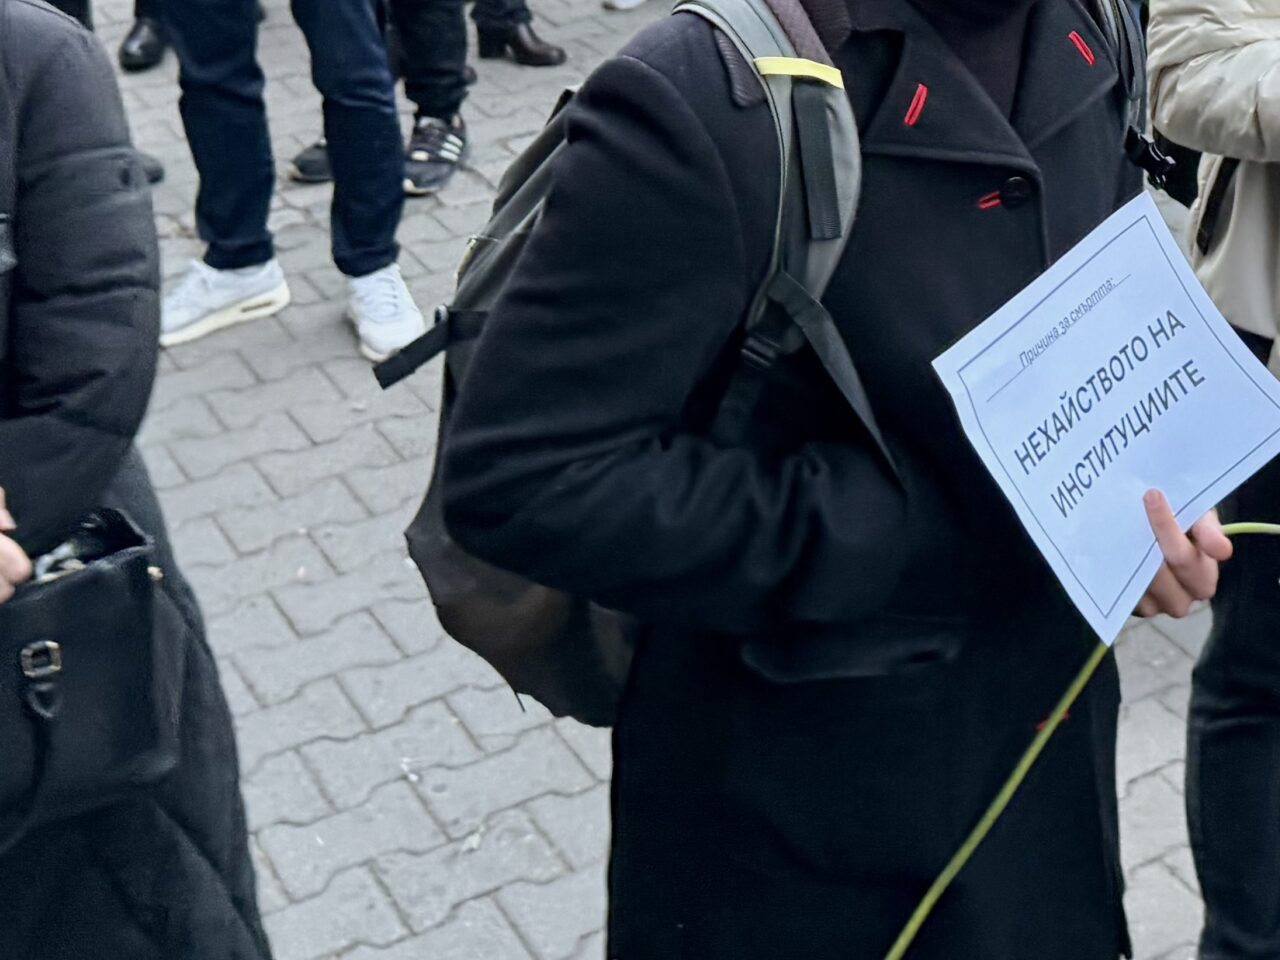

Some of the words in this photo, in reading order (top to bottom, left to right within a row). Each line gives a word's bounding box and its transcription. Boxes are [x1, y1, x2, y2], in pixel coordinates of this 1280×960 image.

[1014, 335, 1149, 475] НЕХАЙСТВОТО
[1147, 309, 1187, 349] НА
[1018, 325, 1061, 370] Причина
[1058, 315, 1072, 336] за
[1069, 276, 1118, 324] смъртта:
[1050, 359, 1206, 519] ИНСТИТУЦИИТЕ
